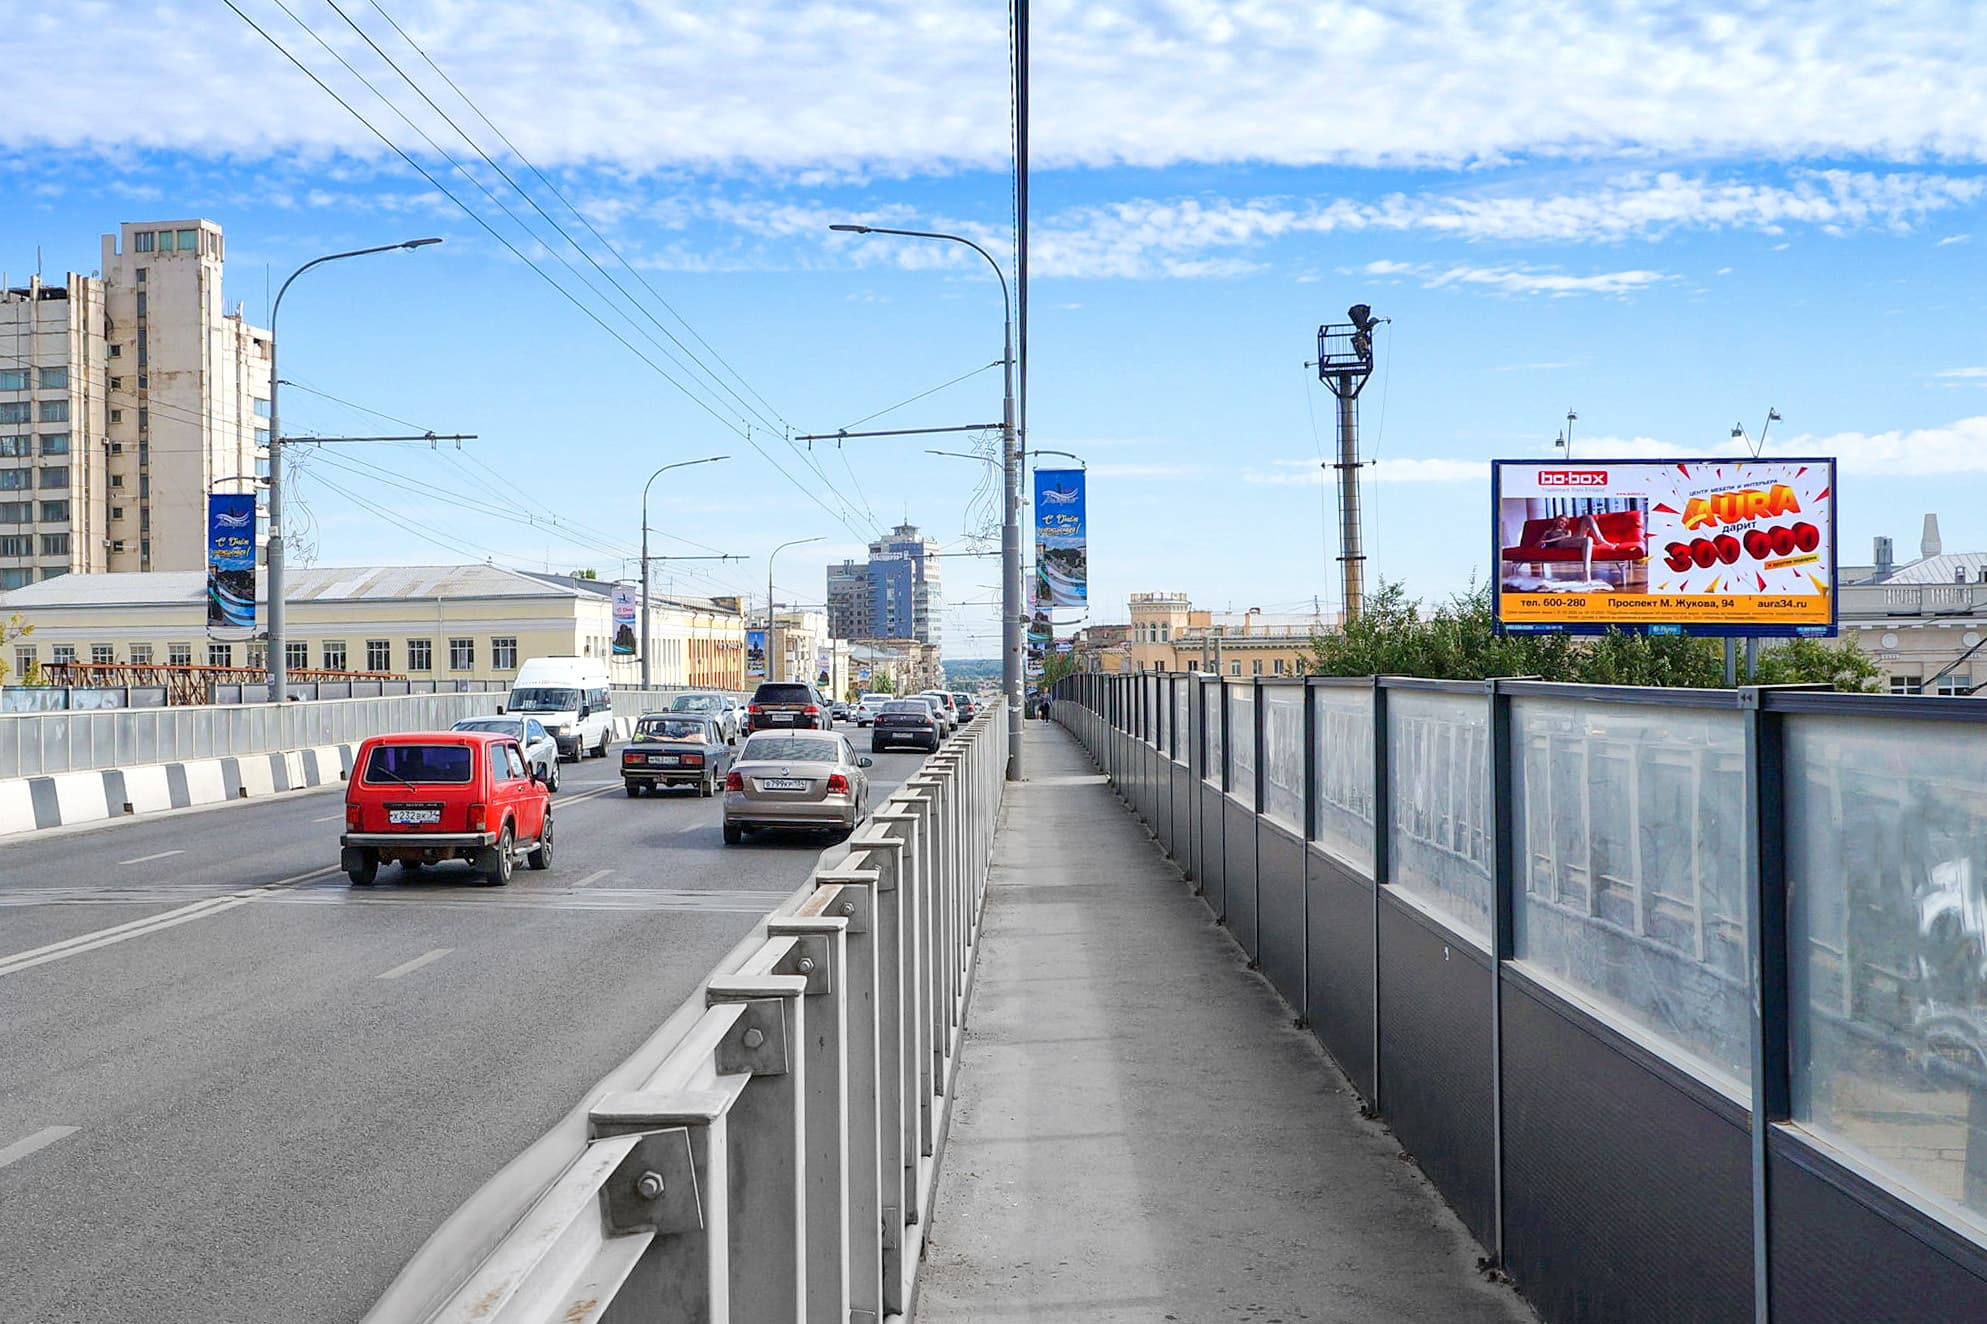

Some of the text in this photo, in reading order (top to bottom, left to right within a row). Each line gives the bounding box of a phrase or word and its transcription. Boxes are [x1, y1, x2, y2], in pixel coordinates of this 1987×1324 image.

[1682, 484, 1801, 530] AURA
[1722, 521, 1757, 534] дарит
[1664, 522, 1820, 572] 300 000
[1521, 598, 1586, 607] тел. 600-280
[1608, 599, 1734, 609] Проспект М. Жукова, 94
[1757, 600, 1807, 608] aura34.ru
